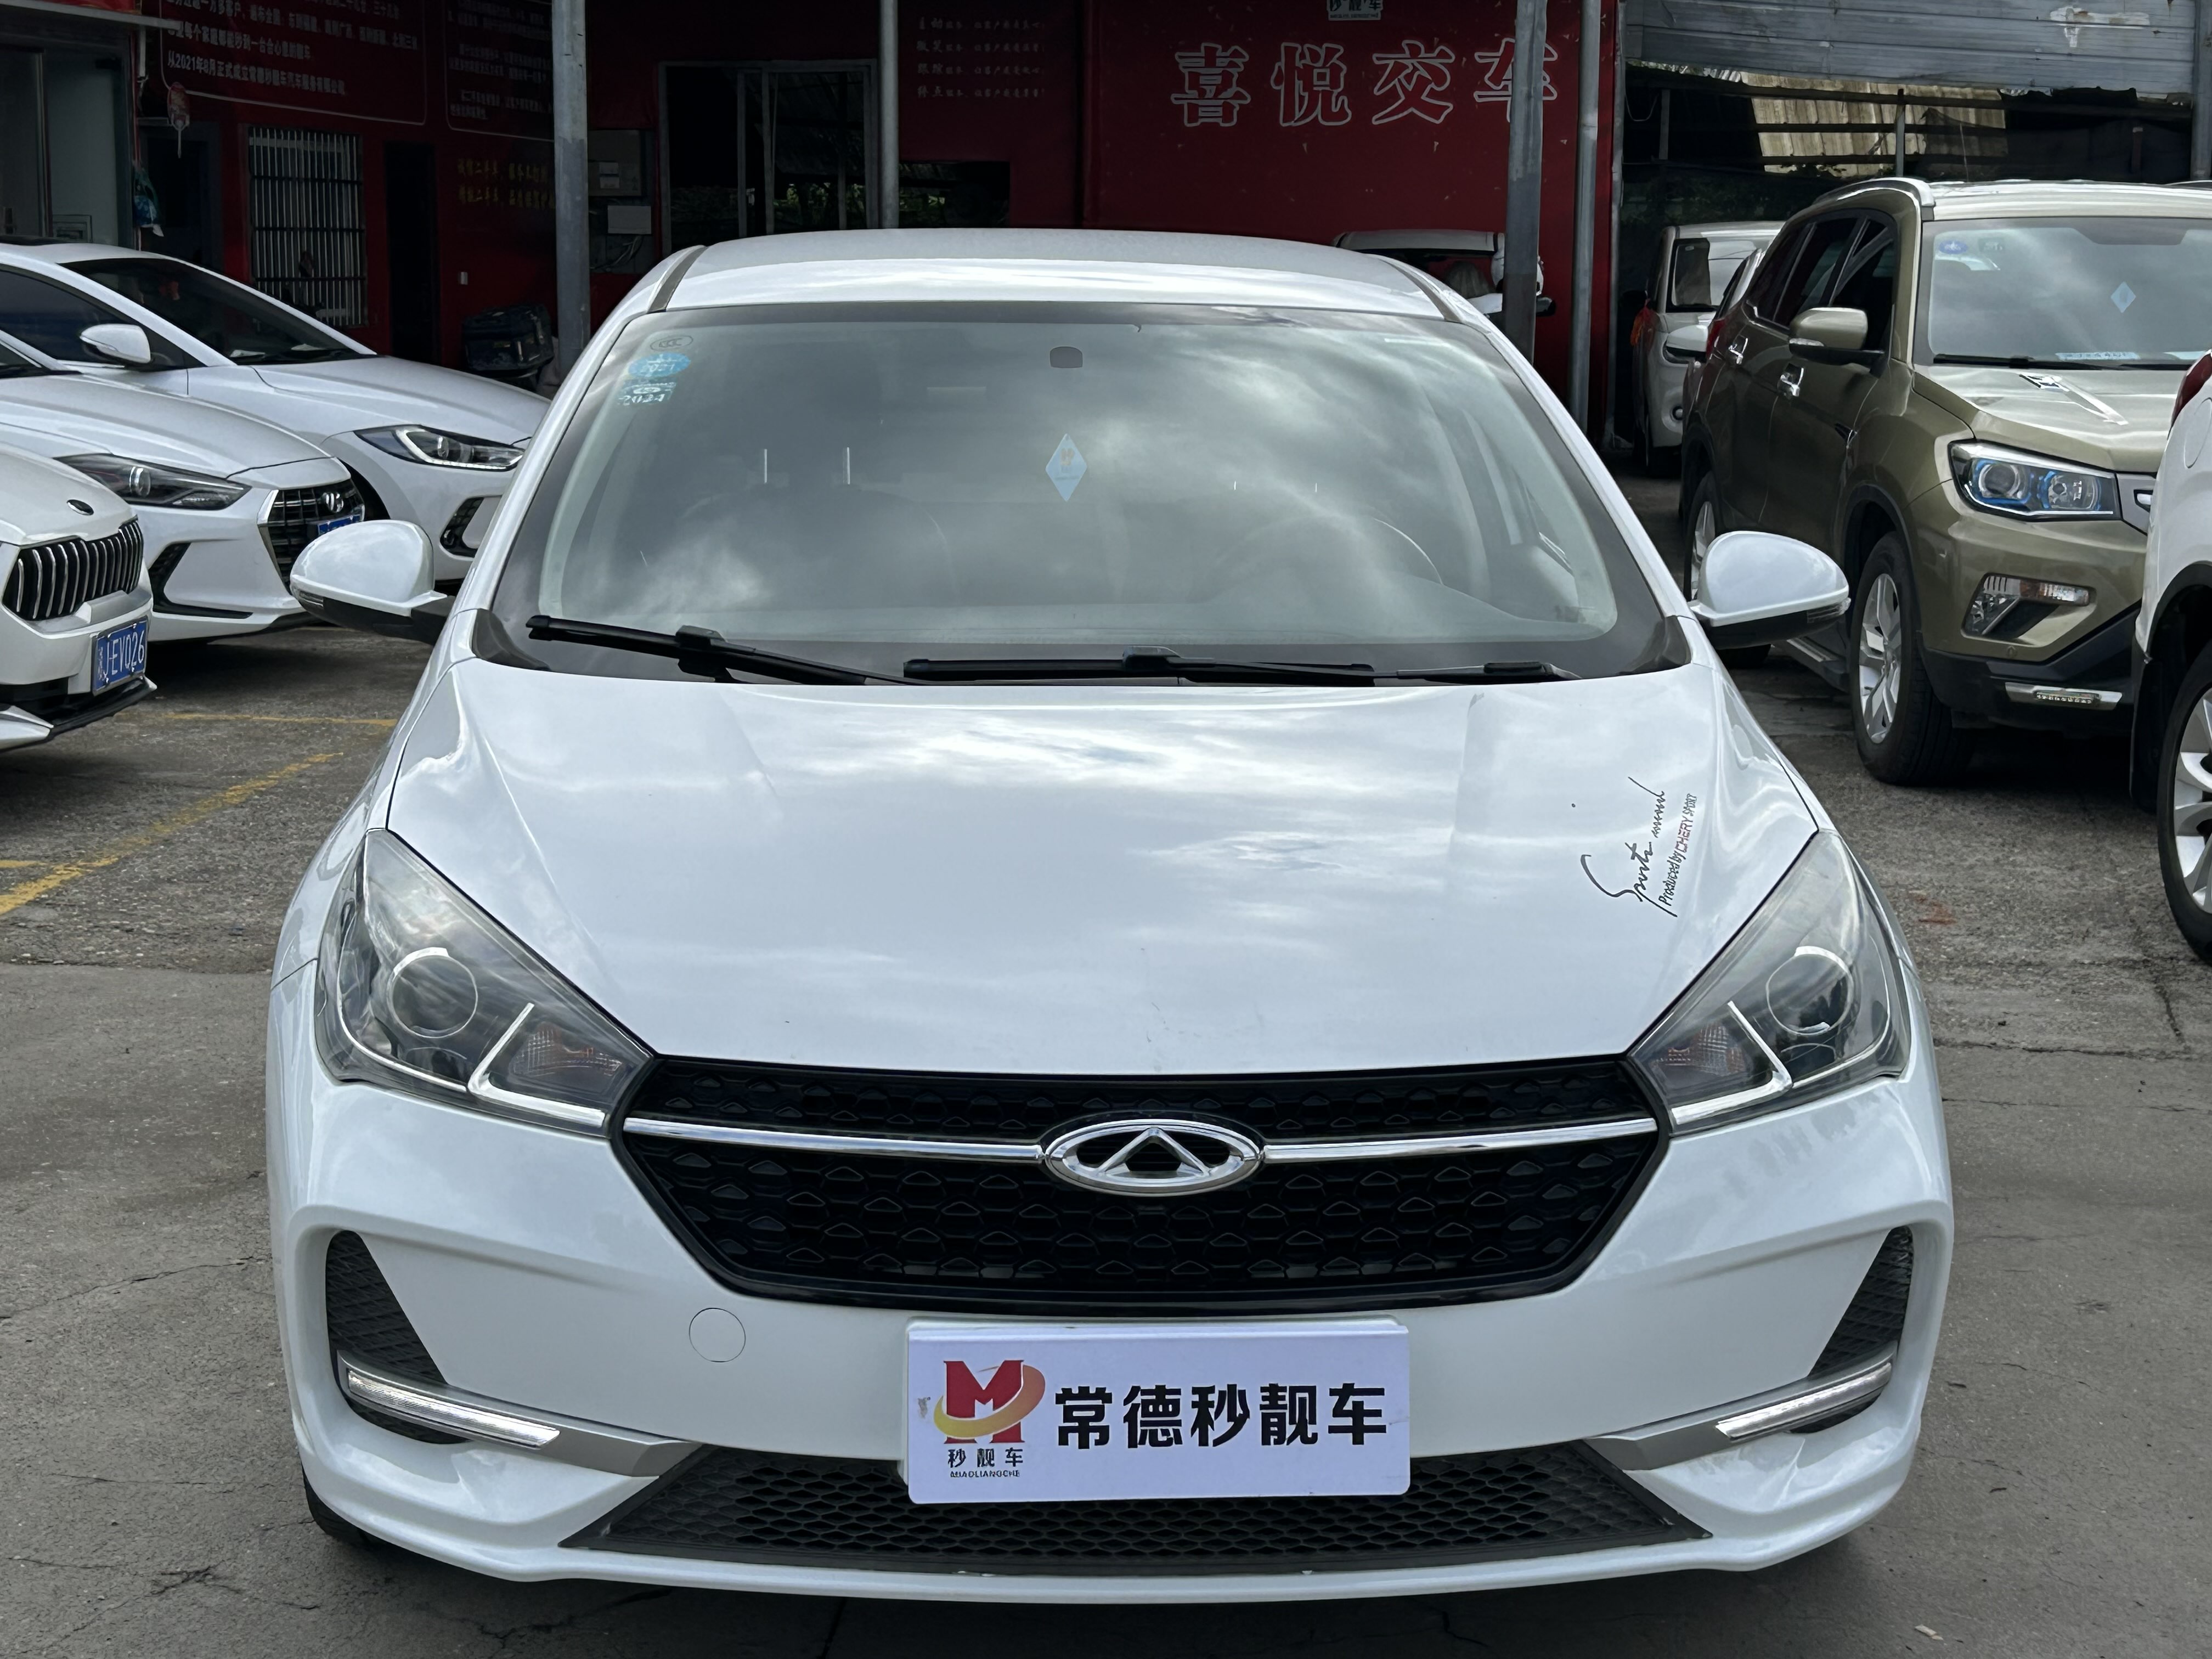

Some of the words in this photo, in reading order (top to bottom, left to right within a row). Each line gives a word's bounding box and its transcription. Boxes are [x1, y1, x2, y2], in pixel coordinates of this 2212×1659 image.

[1675, 815, 1694, 853] CHERY
[1055, 1383, 1387, 1449] 常德秒靓车
[947, 1447, 1023, 1468] 秒靓车
